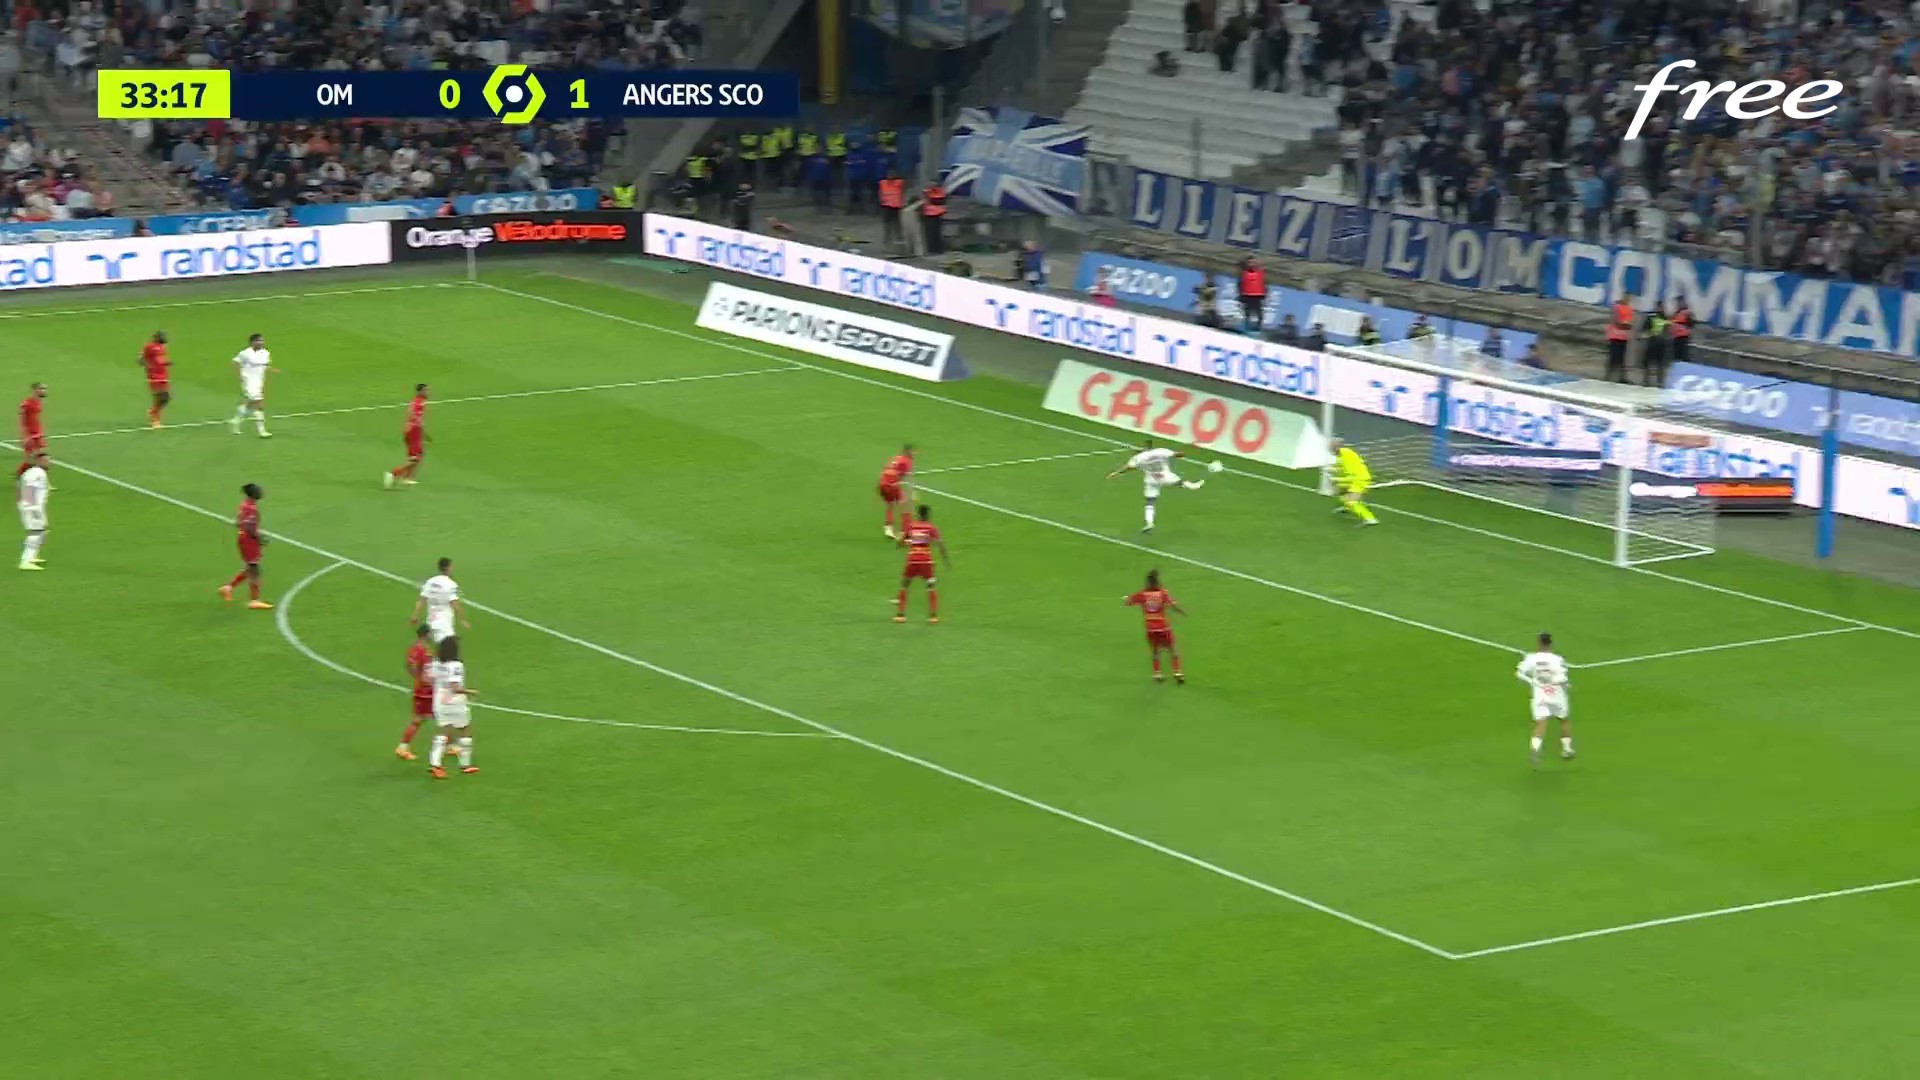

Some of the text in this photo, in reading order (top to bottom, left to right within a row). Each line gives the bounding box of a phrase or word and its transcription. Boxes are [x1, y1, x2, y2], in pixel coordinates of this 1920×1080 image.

[160, 228, 322, 276] randstad
[696, 231, 786, 278] randstad
[840, 260, 937, 311] randstad
[1029, 305, 1136, 356] randstad
[1203, 343, 1320, 396] randstad
[1077, 371, 1271, 453] CAZOO
